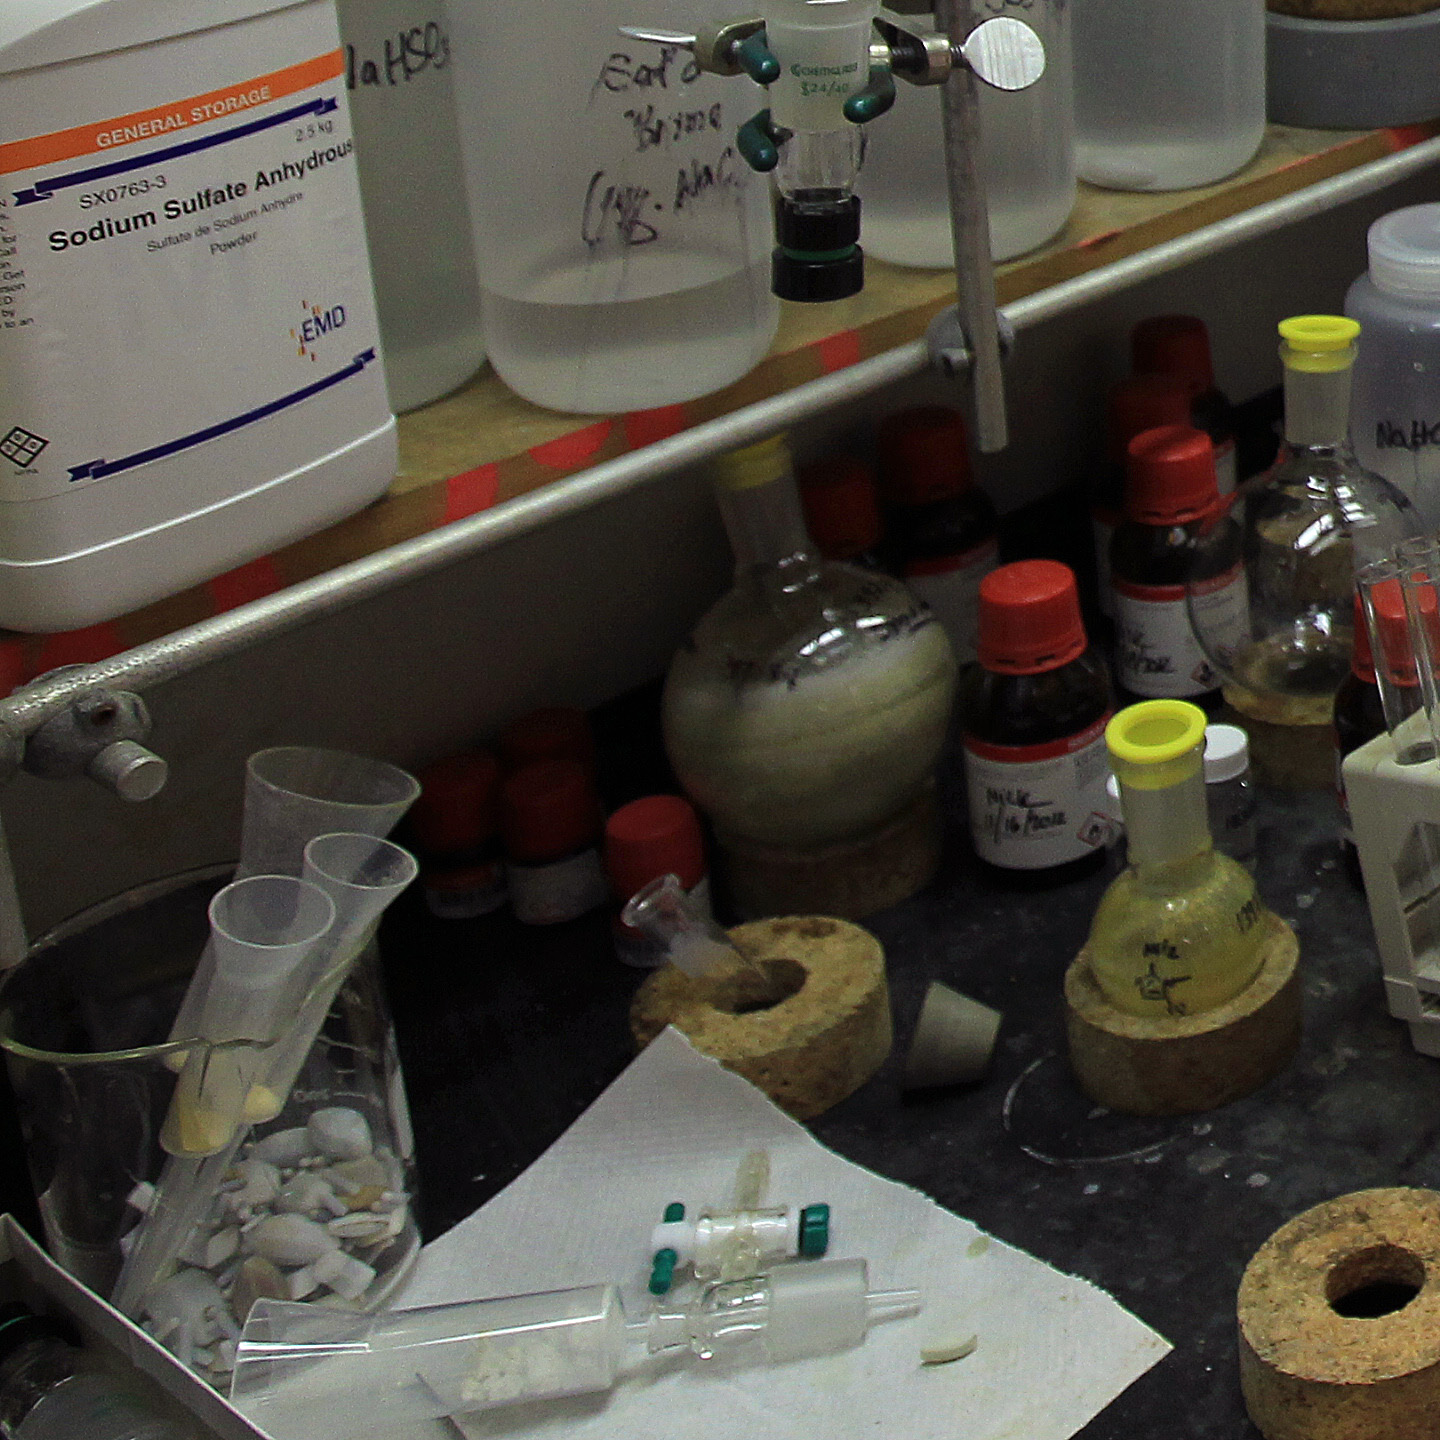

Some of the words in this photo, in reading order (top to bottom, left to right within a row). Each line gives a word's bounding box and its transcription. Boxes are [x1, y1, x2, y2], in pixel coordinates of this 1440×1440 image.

[96, 114, 189, 149] GENERAL
[191, 85, 272, 124] STORAGE
[48, 206, 158, 253] Sodium
[164, 178, 248, 221] Sulfate
[254, 137, 354, 193] Anhydrous
[79, 174, 168, 211] SX0763-3
[146, 228, 192, 254] Sulfate
[212, 209, 259, 233] Sodium
[209, 229, 259, 256] Powder
[301, 304, 348, 344] EMD
